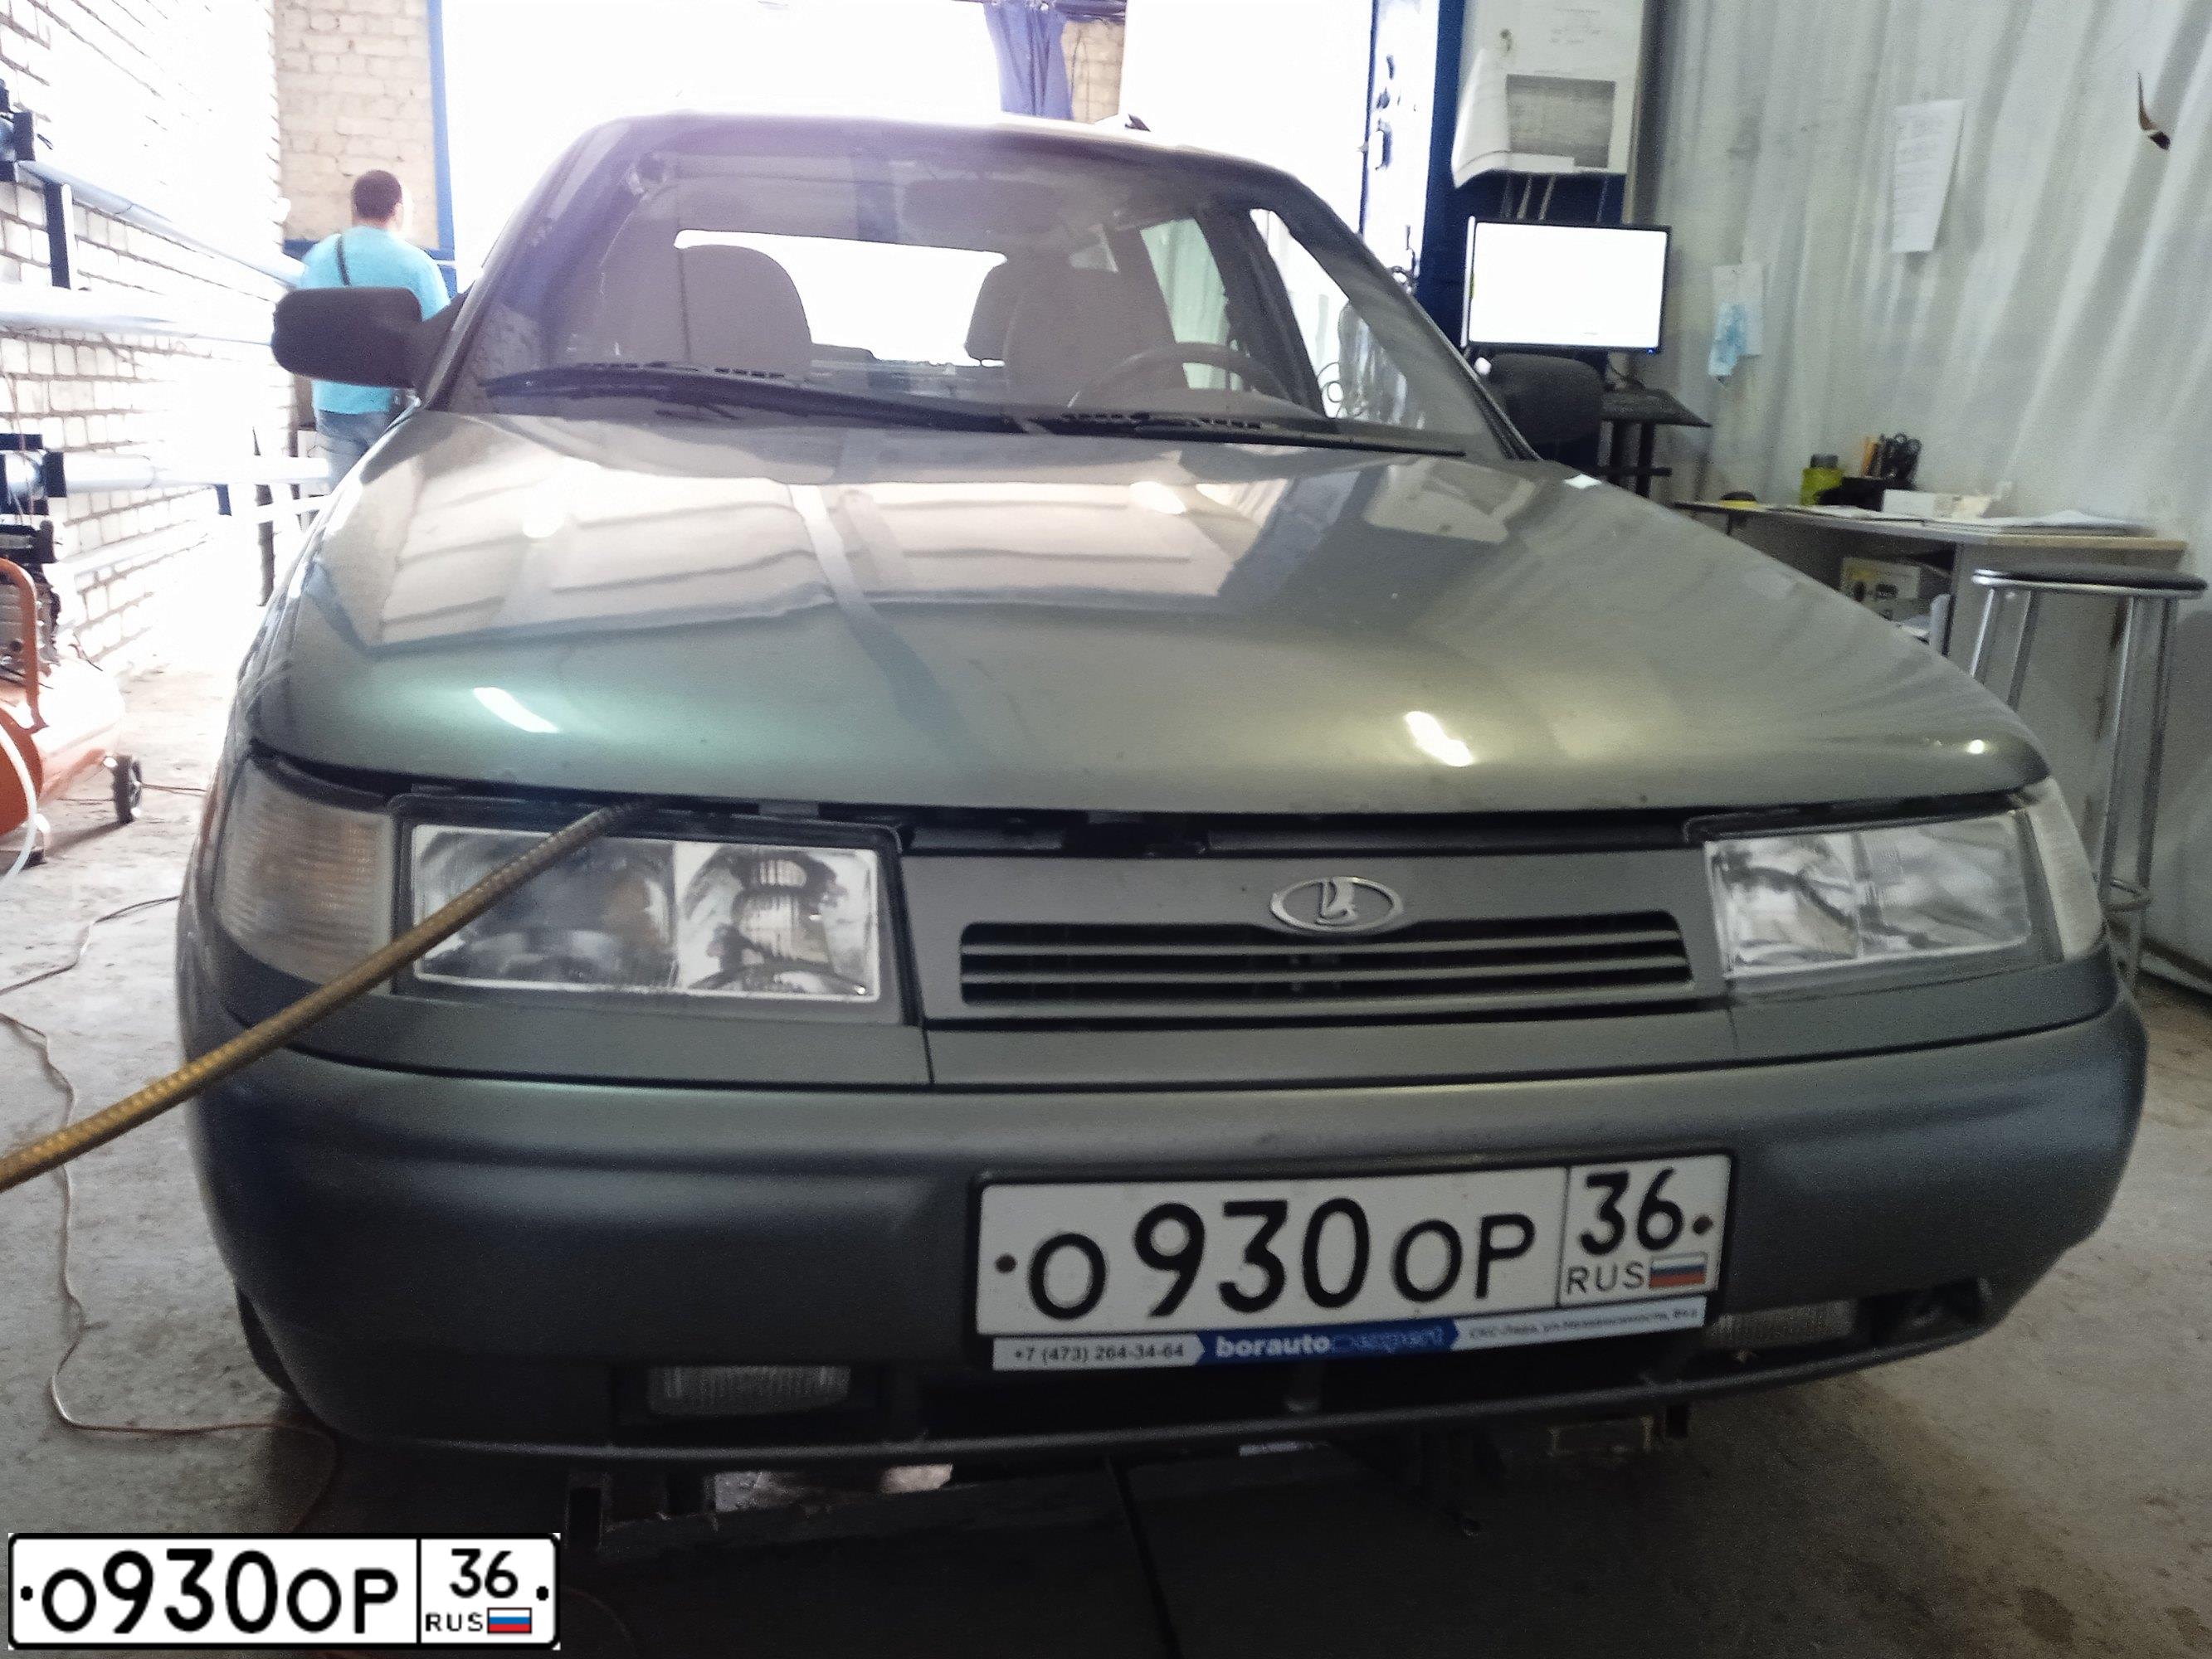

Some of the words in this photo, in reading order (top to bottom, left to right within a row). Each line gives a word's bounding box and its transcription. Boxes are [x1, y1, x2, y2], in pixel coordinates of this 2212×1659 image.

[1578, 1167, 1683, 1256] 36
[1565, 1260, 1645, 1296] RUS
[1216, 1332, 1331, 1357] borauto
